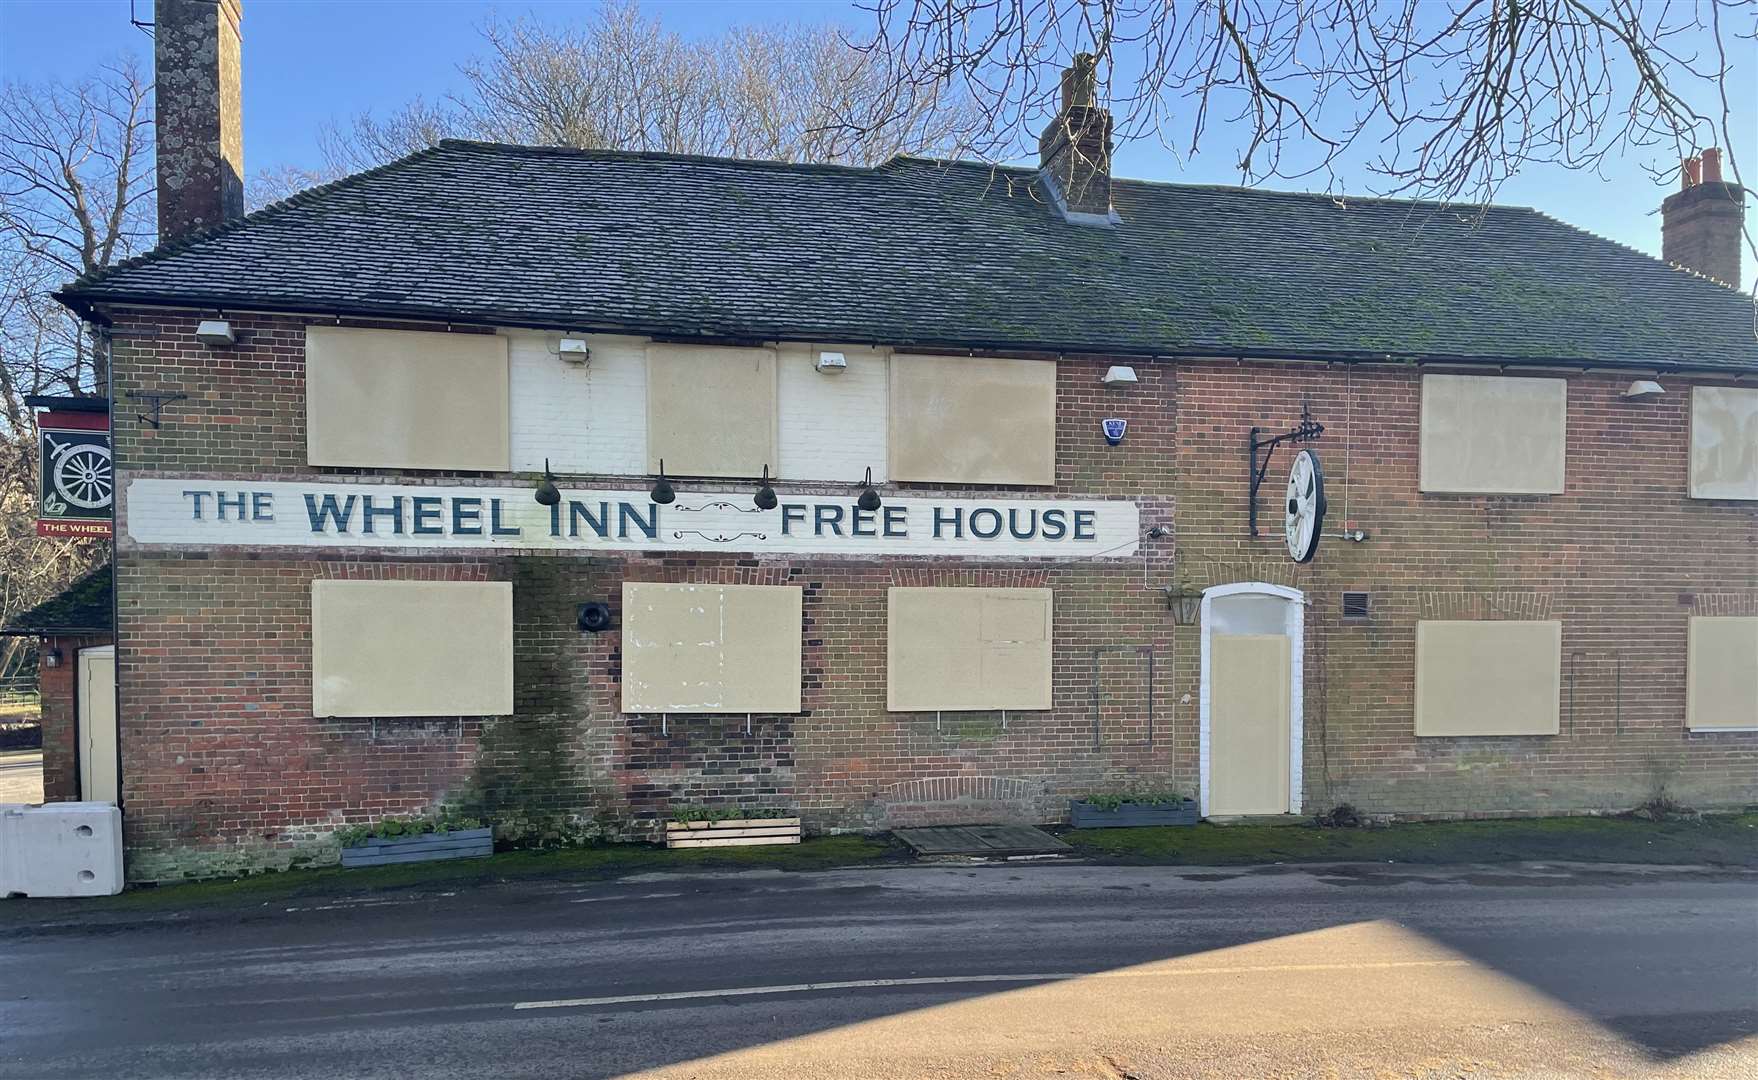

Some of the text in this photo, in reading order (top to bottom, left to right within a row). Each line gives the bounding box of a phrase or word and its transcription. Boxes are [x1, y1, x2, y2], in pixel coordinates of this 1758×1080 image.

[43, 523, 111, 533] THE WHEEL
[183, 490, 1097, 540] THE WHEEL INN FREE HOUSE
